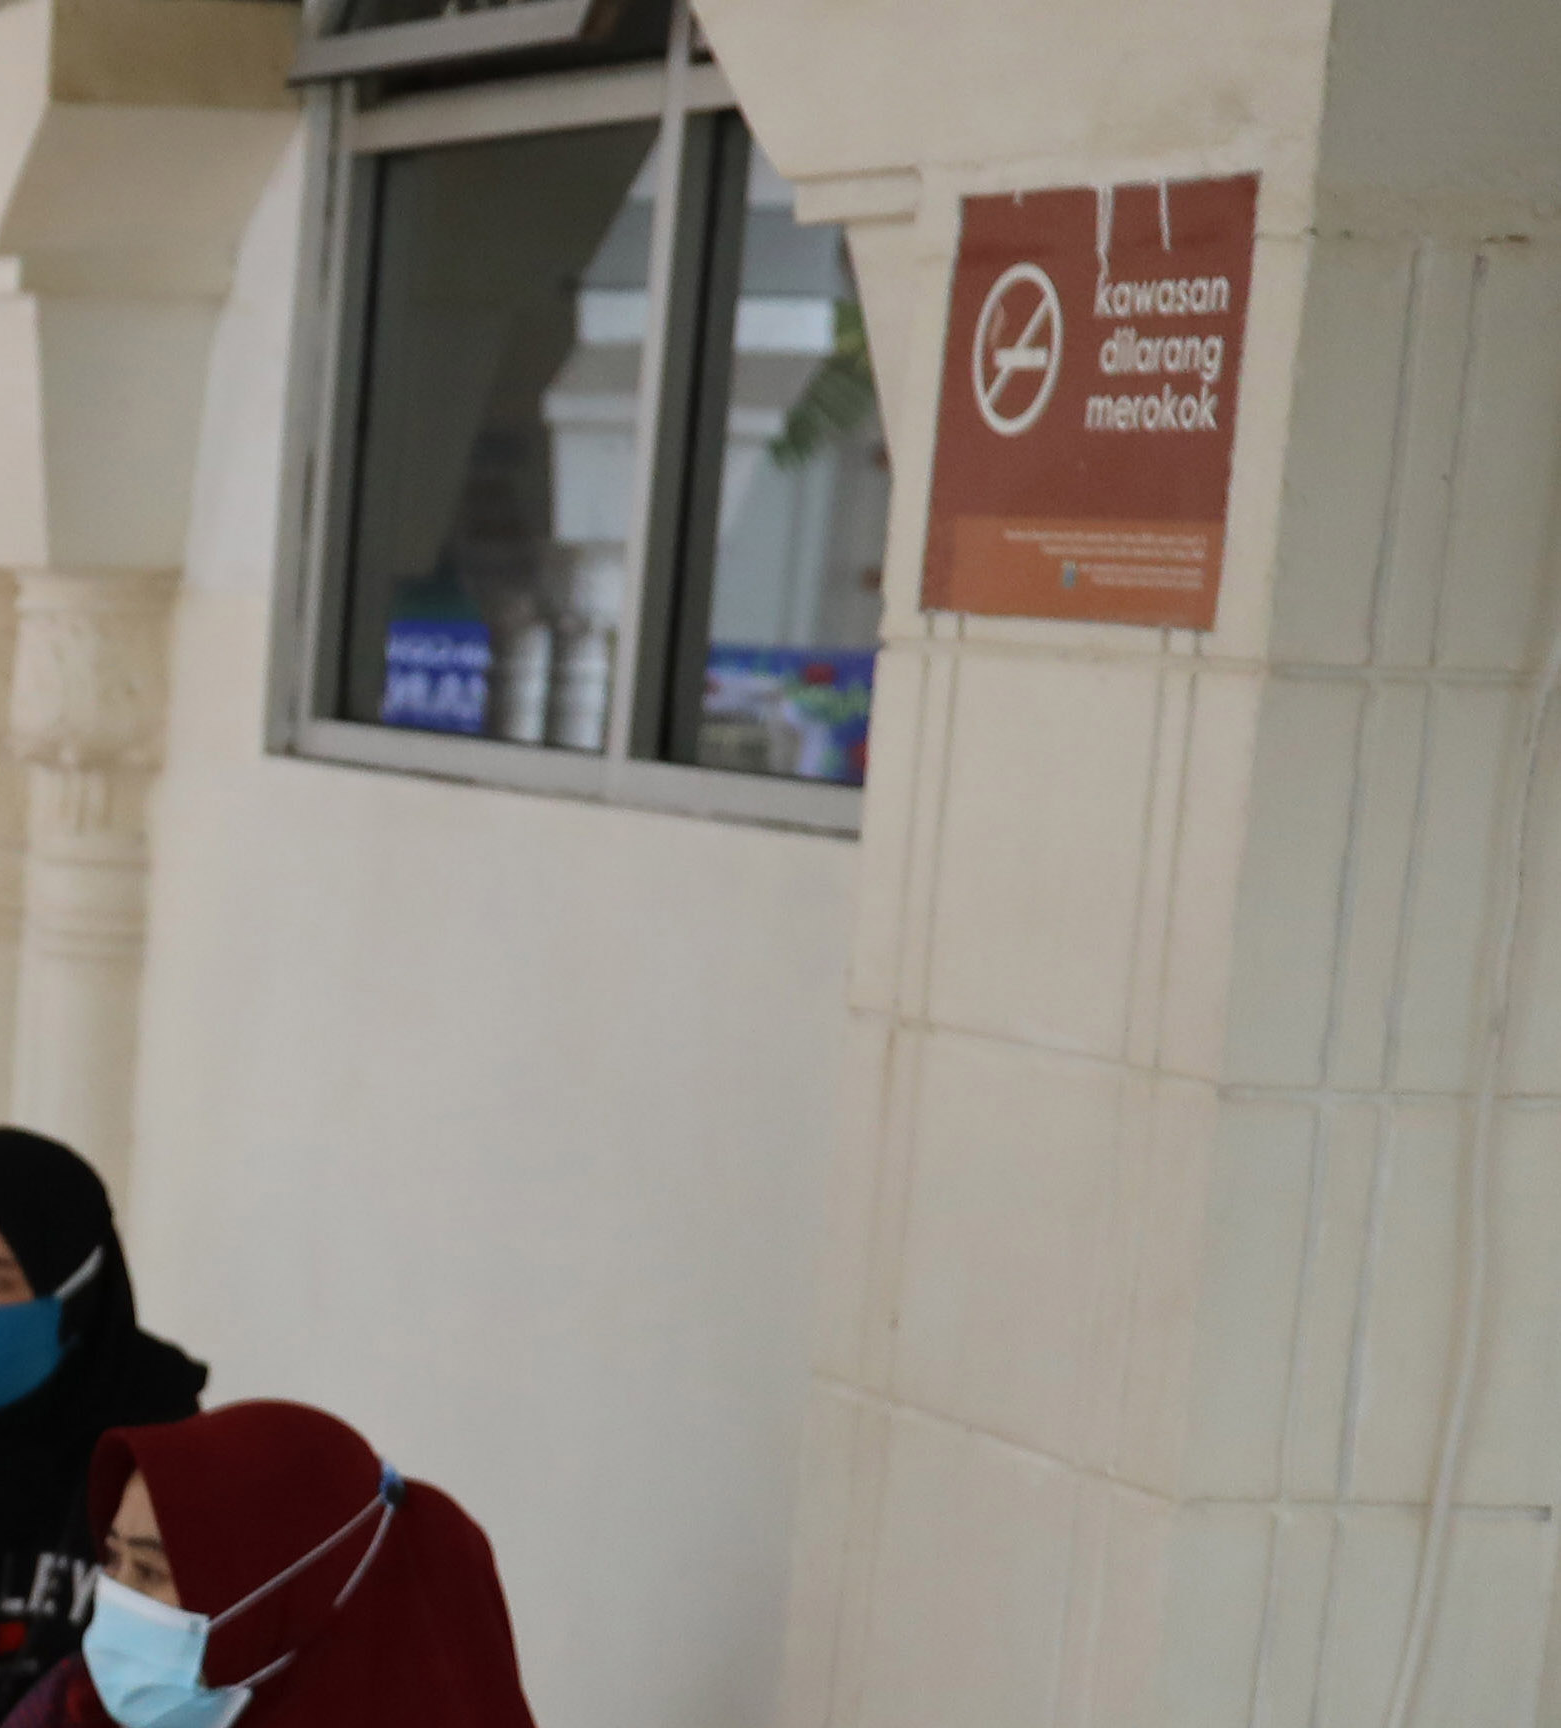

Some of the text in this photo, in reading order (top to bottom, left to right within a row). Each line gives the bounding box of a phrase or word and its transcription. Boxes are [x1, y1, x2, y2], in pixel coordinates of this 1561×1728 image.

[1094, 274, 1230, 318] kawasan
[1099, 326, 1225, 381] dilarang
[1085, 382, 1218, 431] merokok
